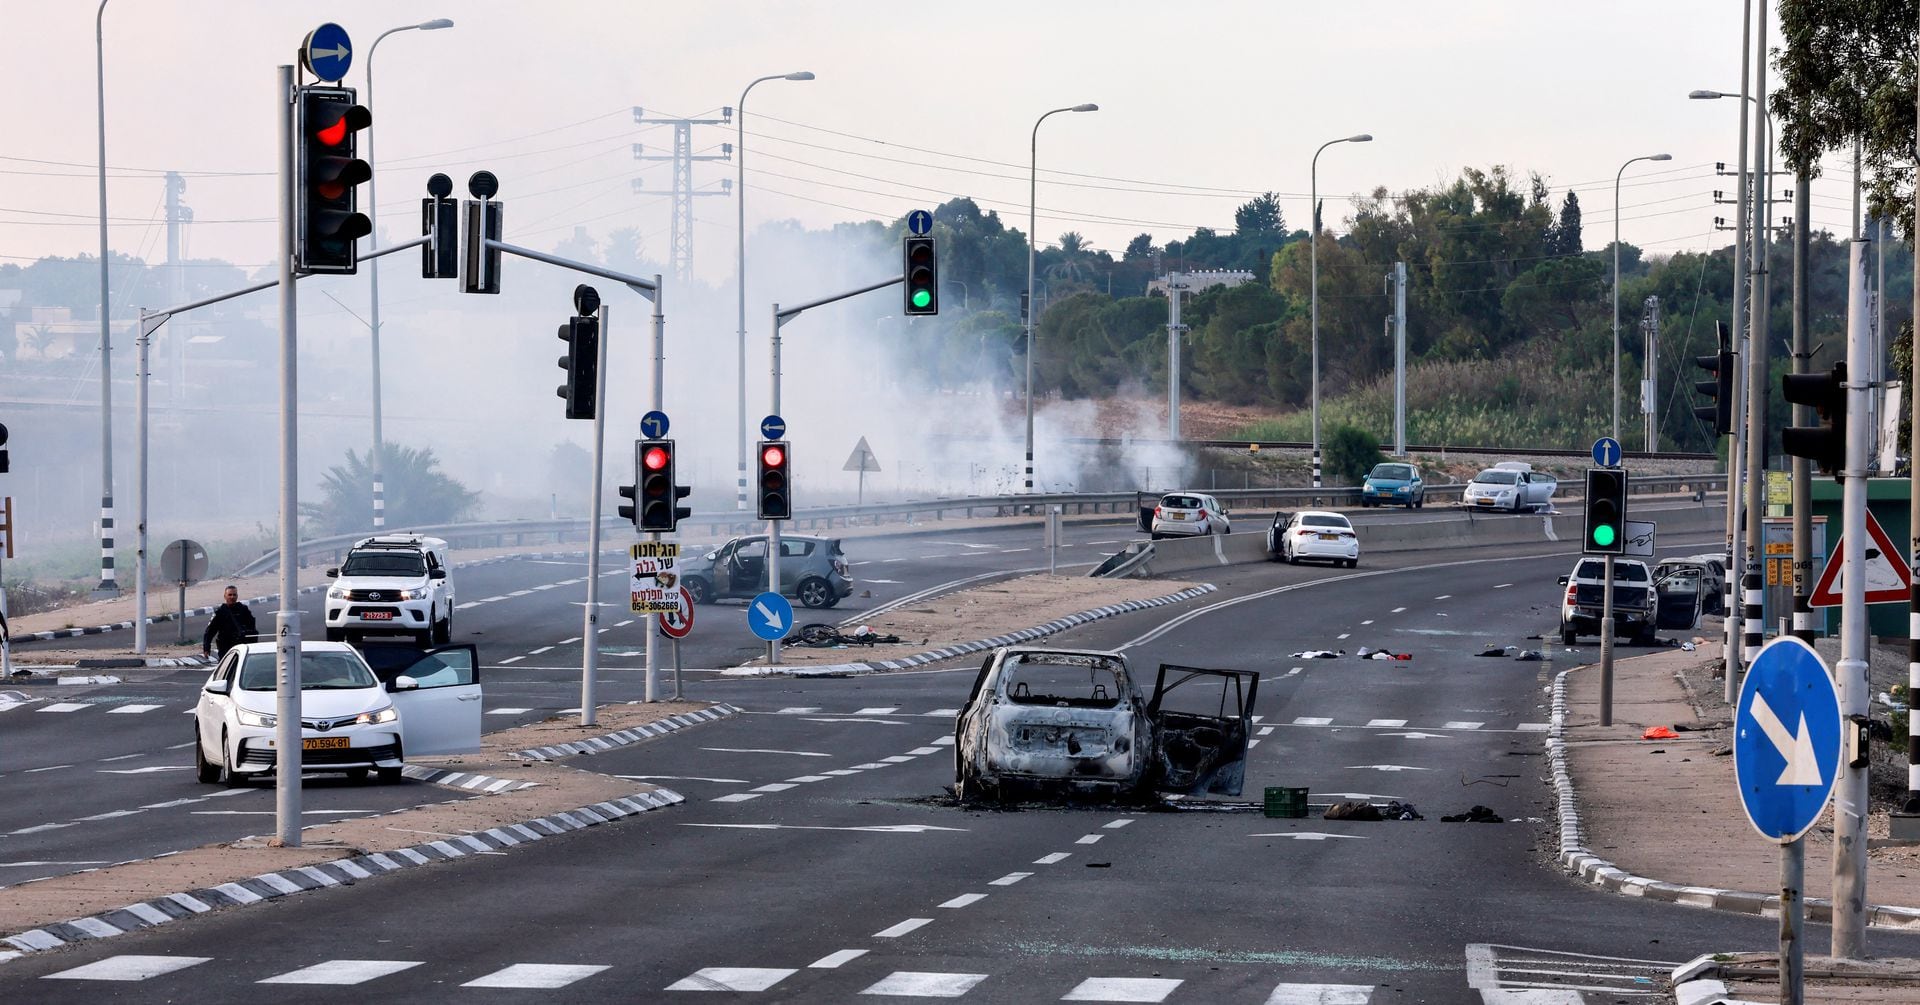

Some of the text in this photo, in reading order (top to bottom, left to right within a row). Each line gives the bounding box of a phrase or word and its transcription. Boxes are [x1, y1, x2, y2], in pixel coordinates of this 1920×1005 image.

[636, 558, 674, 574] של גלה
[632, 588, 663, 601] מפלסים
